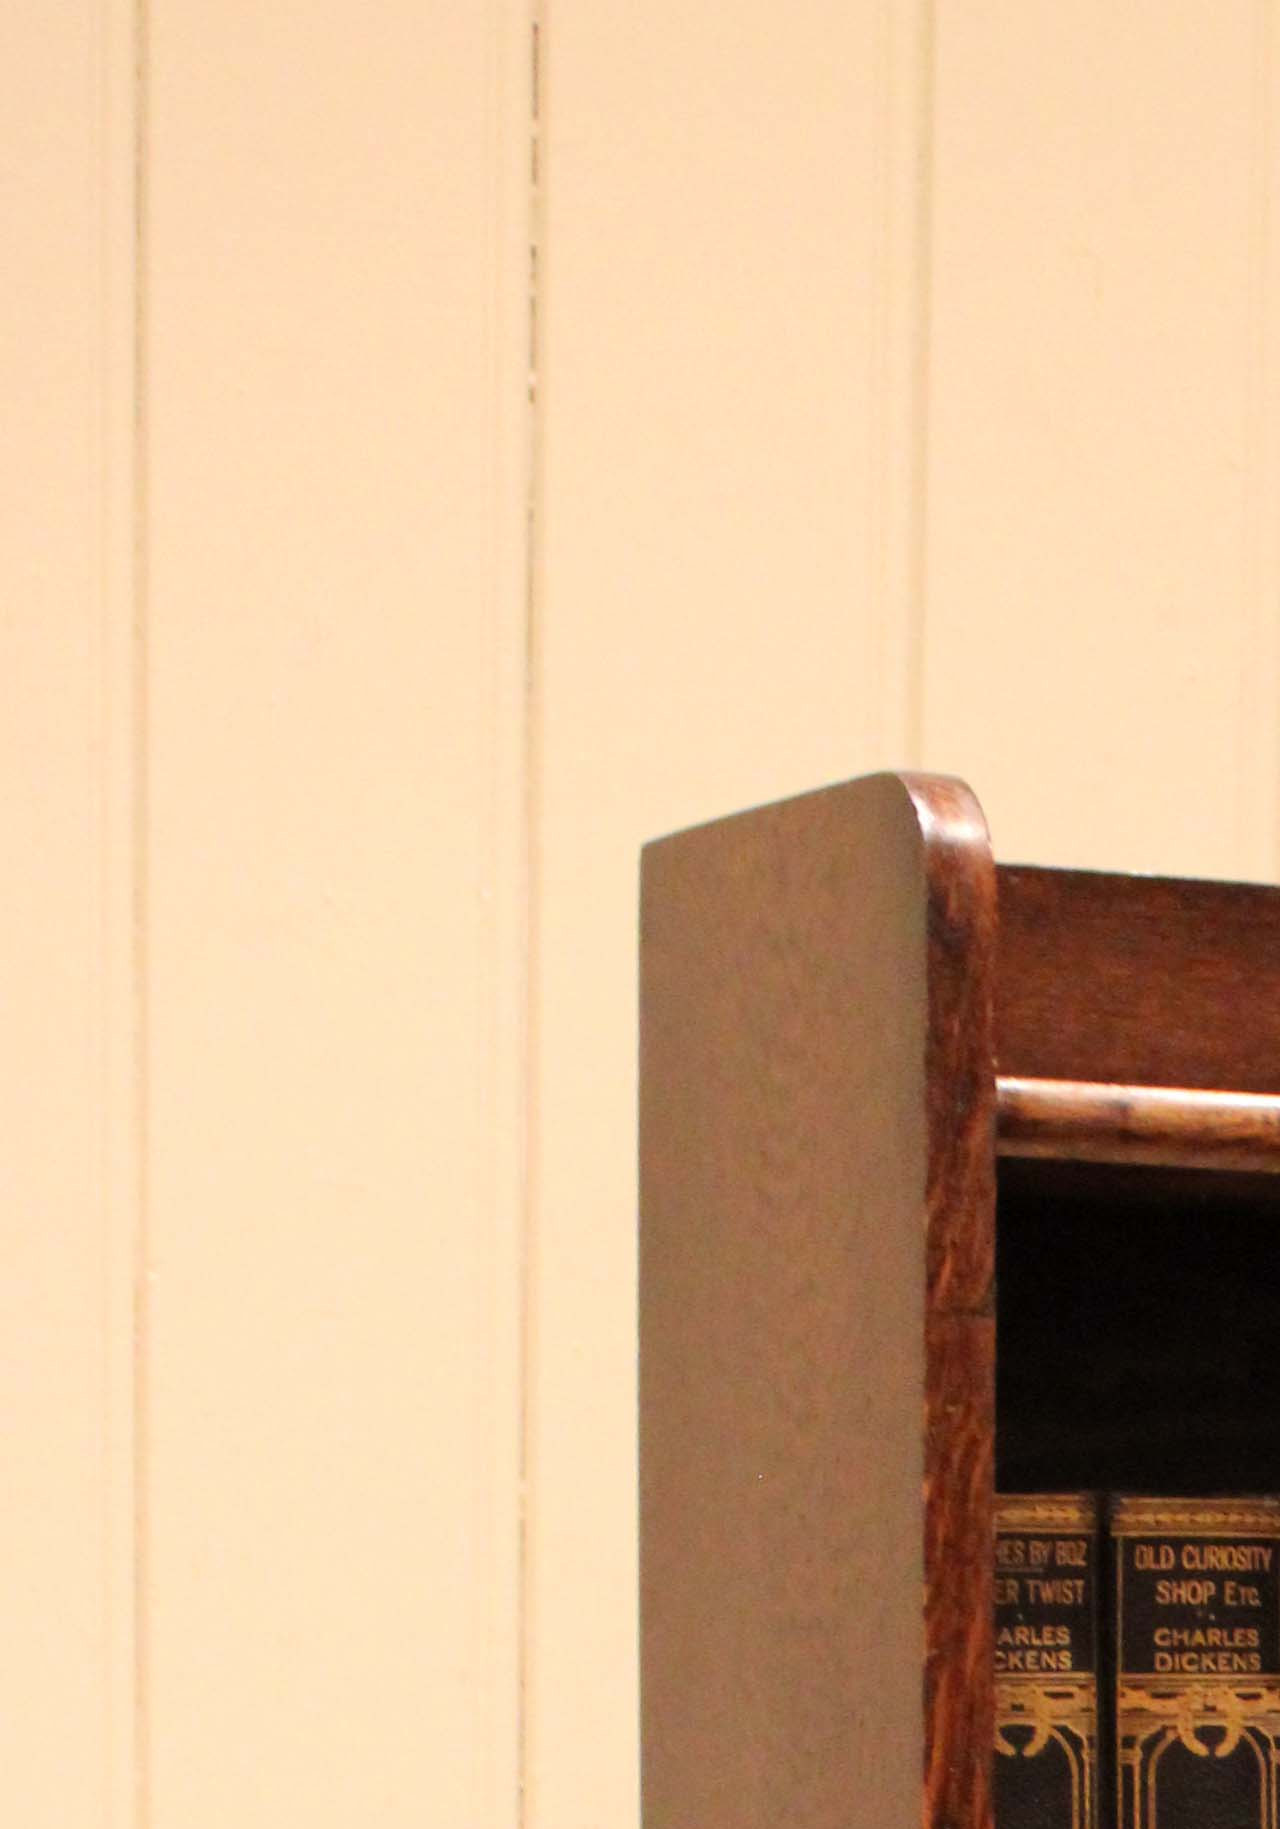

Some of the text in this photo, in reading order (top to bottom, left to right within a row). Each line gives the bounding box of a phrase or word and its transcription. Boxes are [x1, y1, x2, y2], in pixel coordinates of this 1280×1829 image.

[1136, 1543, 1272, 1571] OLD CURIOSITY
[1156, 1580, 1216, 1607] SHOP
[1154, 1627, 1260, 1648] CHARLES
[1154, 1651, 1261, 1673] DICKENS
